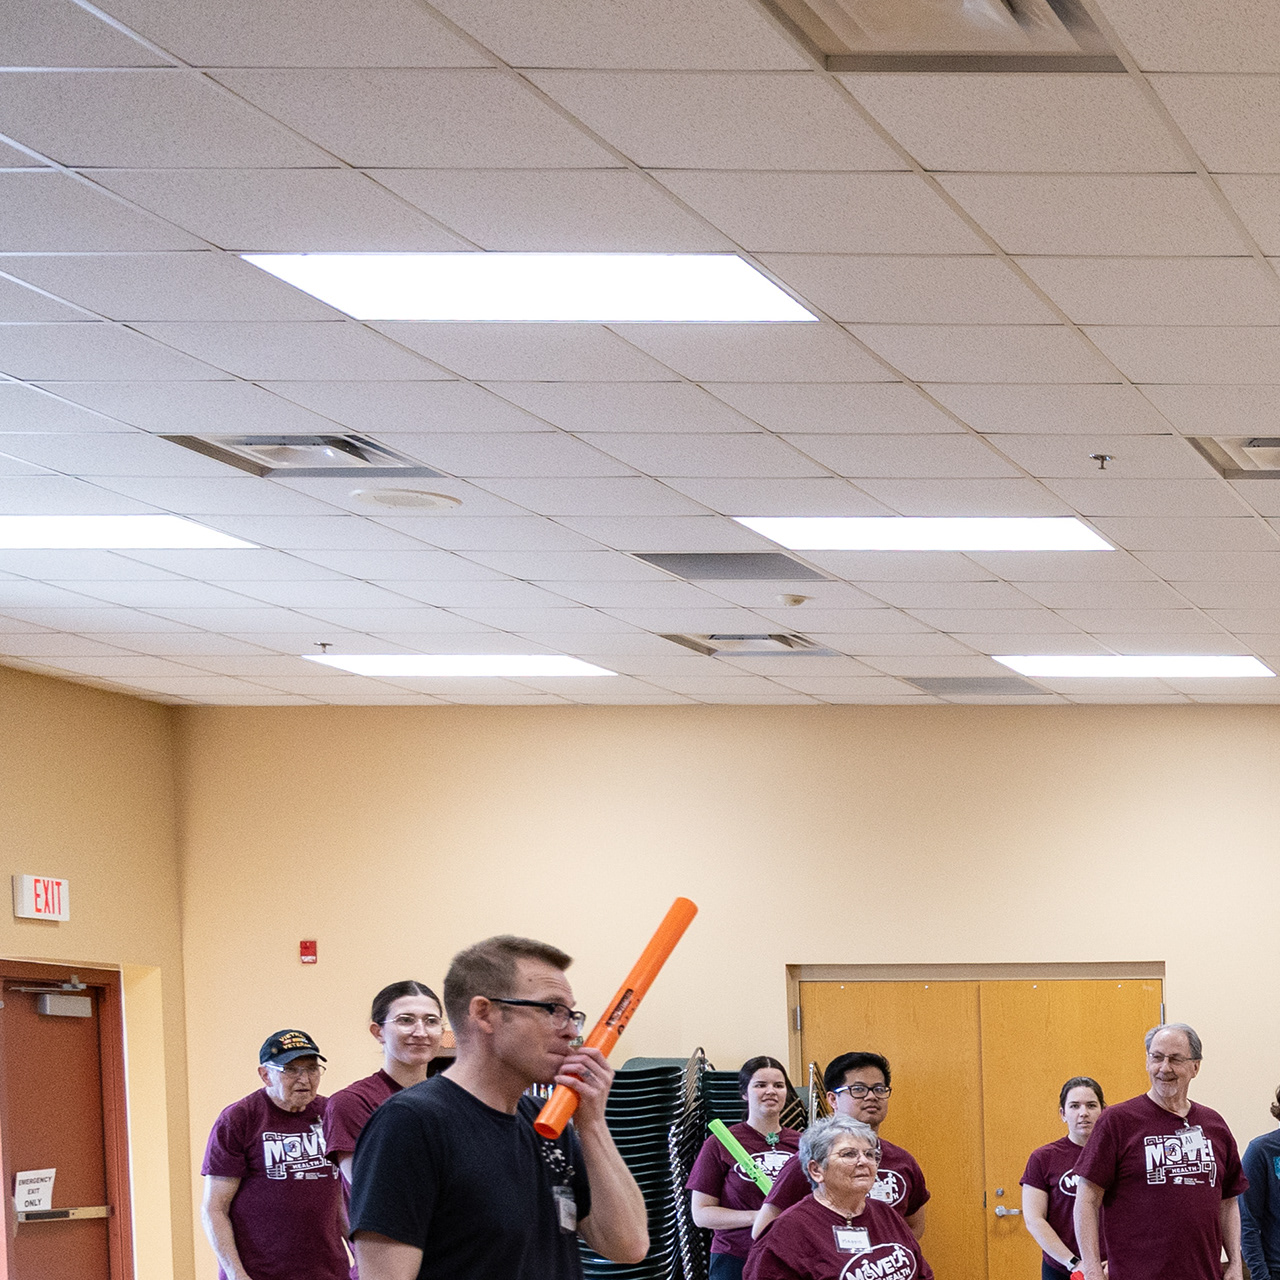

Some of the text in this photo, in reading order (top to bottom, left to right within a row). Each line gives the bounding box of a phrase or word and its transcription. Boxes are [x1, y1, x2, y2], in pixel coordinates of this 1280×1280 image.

[34, 879, 62, 915] EXIT
[292, 1160, 320, 1169] HEALTH
[1171, 1166, 1198, 1174] HEALTH
[19, 1176, 52, 1186] EMERGENCY
[24, 1198, 42, 1207] ONLY
